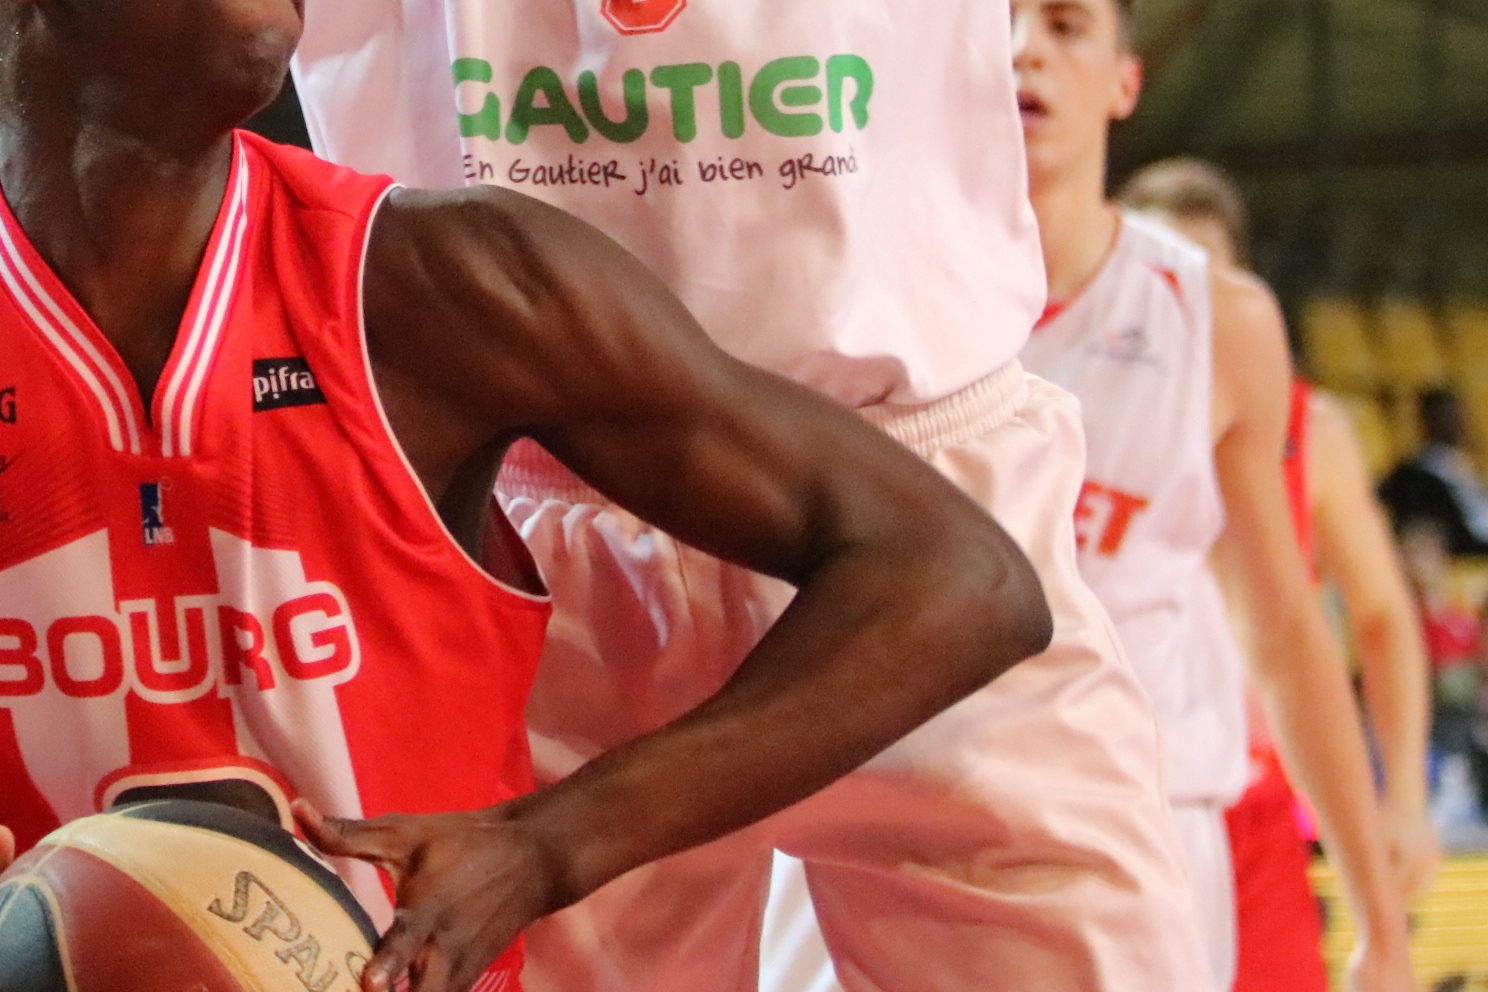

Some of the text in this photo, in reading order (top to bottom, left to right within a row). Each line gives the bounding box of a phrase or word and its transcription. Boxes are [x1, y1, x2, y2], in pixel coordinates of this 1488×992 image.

[451, 54, 874, 144] GAUTIER
[634, 159, 683, 195] j'ai
[699, 157, 763, 183] bien
[144, 527, 174, 545] LNB
